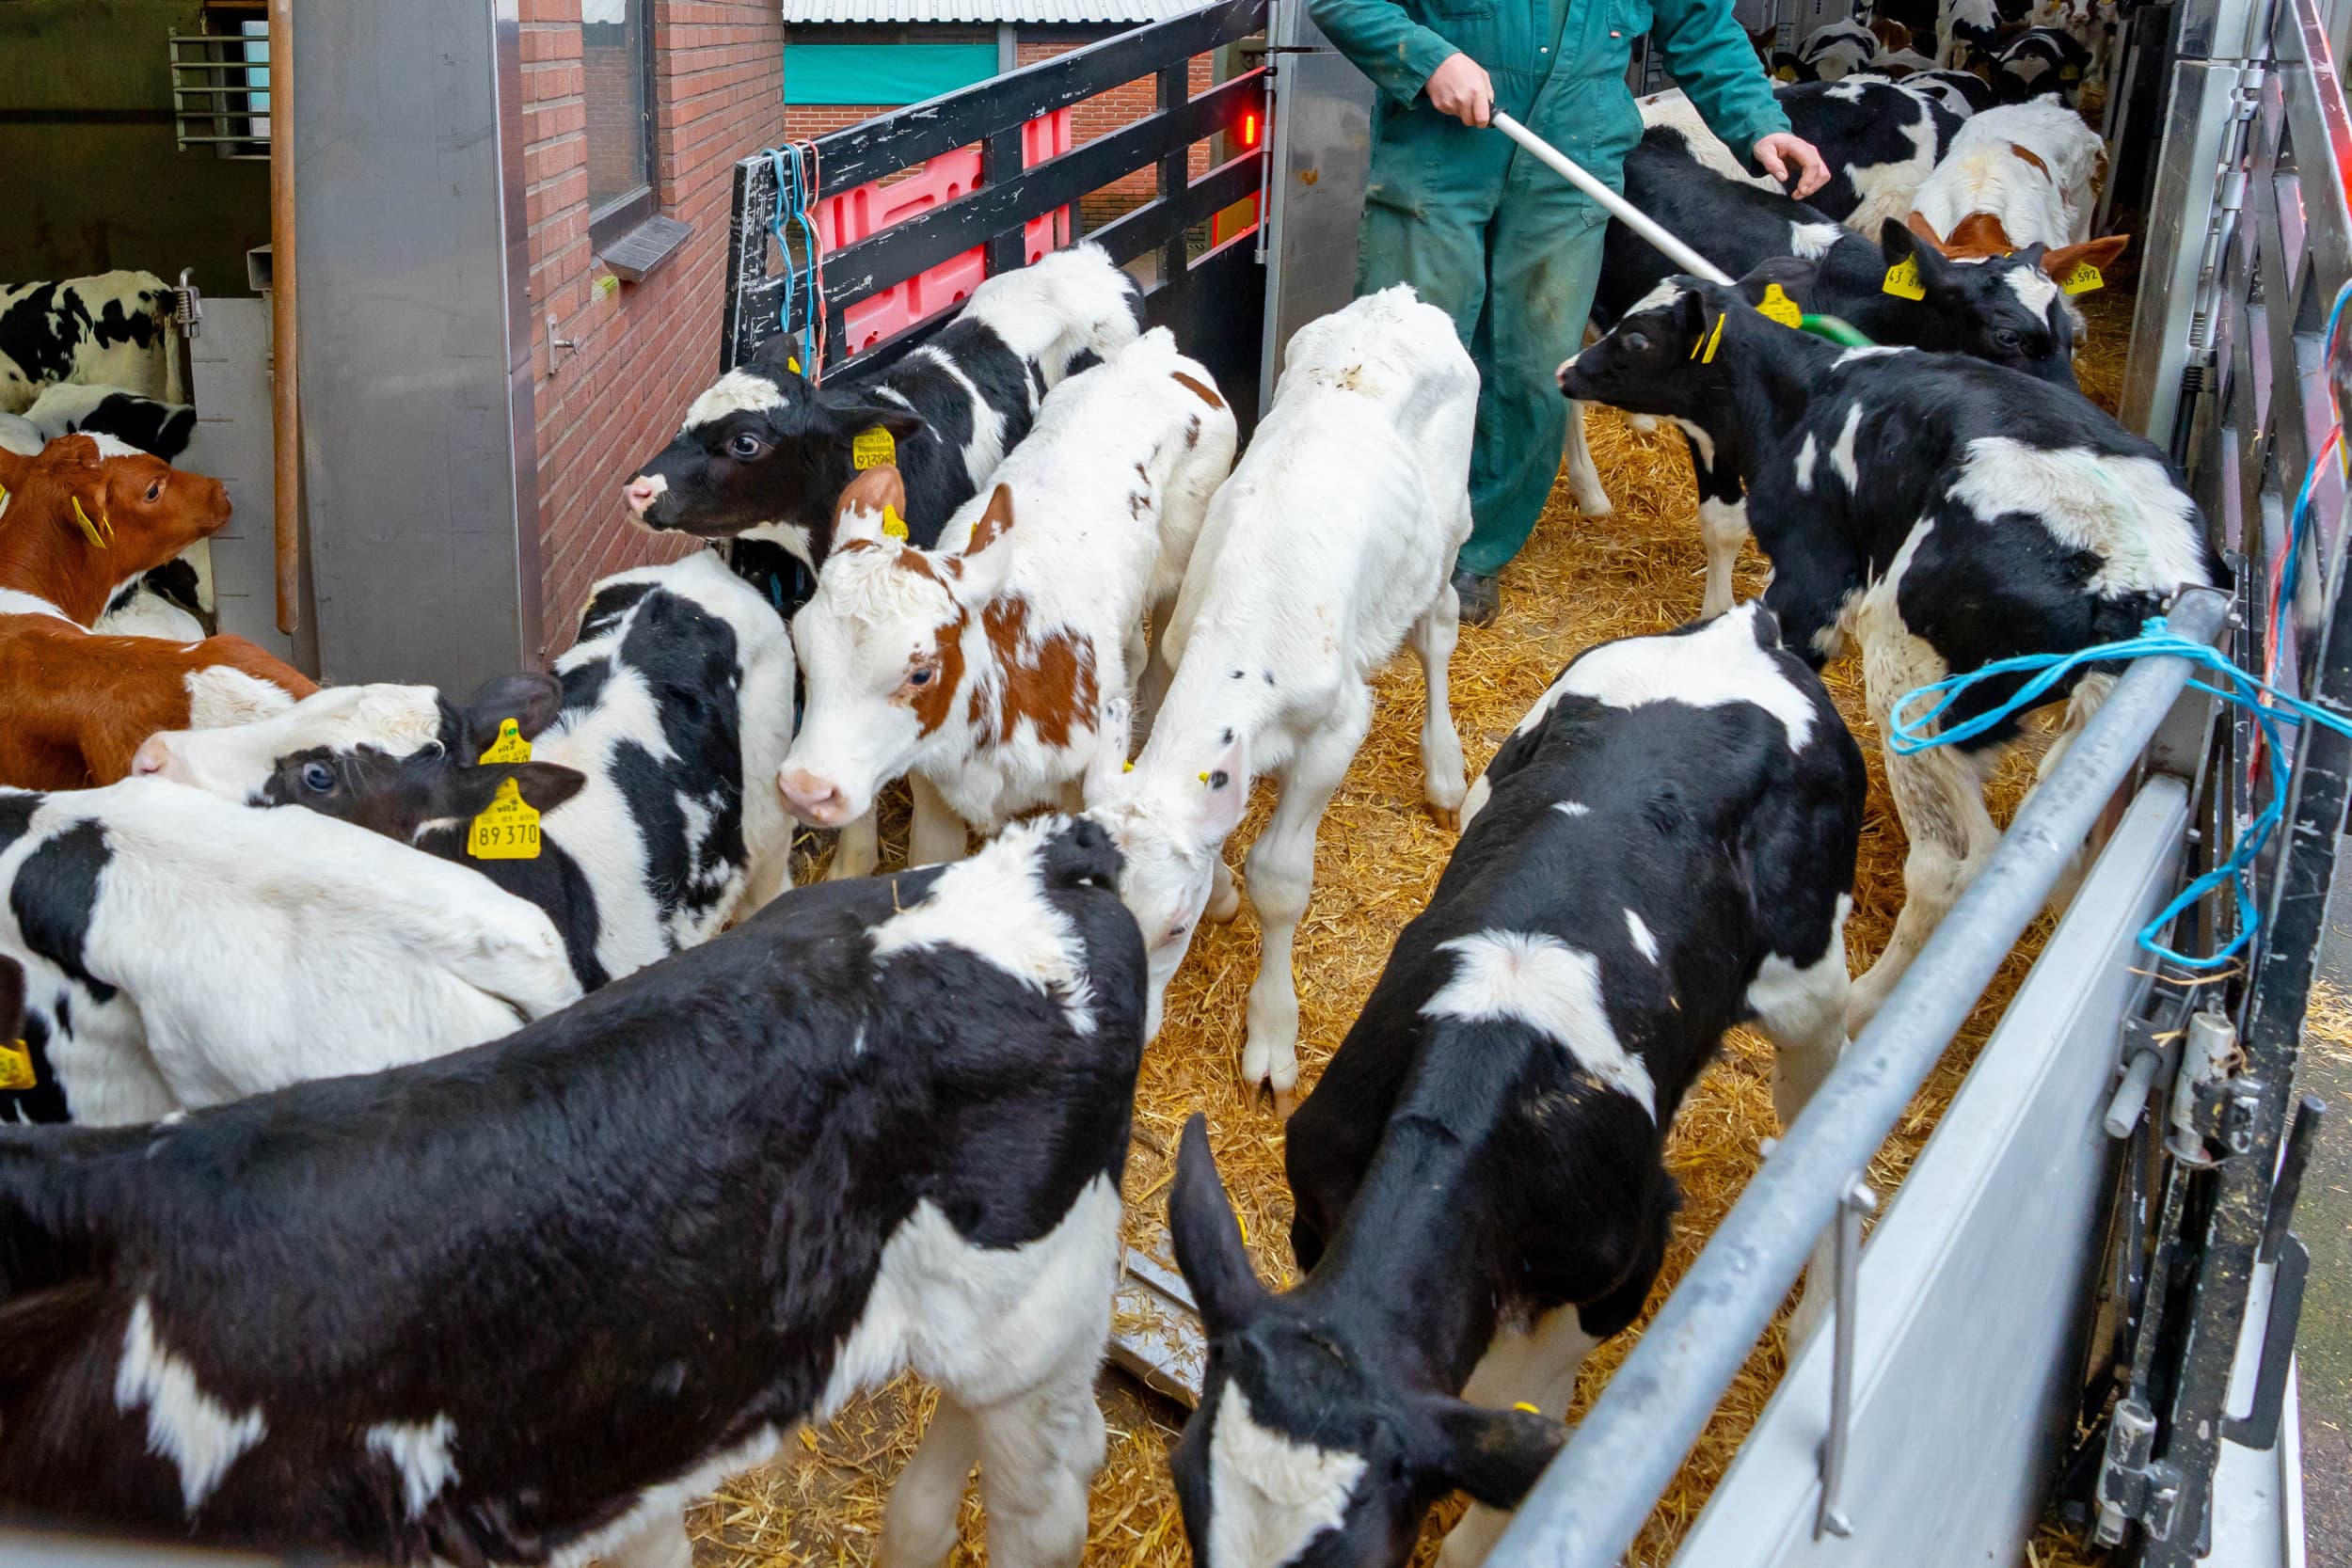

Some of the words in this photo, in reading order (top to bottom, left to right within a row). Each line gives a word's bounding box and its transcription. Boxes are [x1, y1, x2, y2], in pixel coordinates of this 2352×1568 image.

[1889, 271, 1903, 283] 43
[2077, 270, 2098, 282] 592
[480, 826, 501, 846] 89
[506, 824, 537, 845] 370
